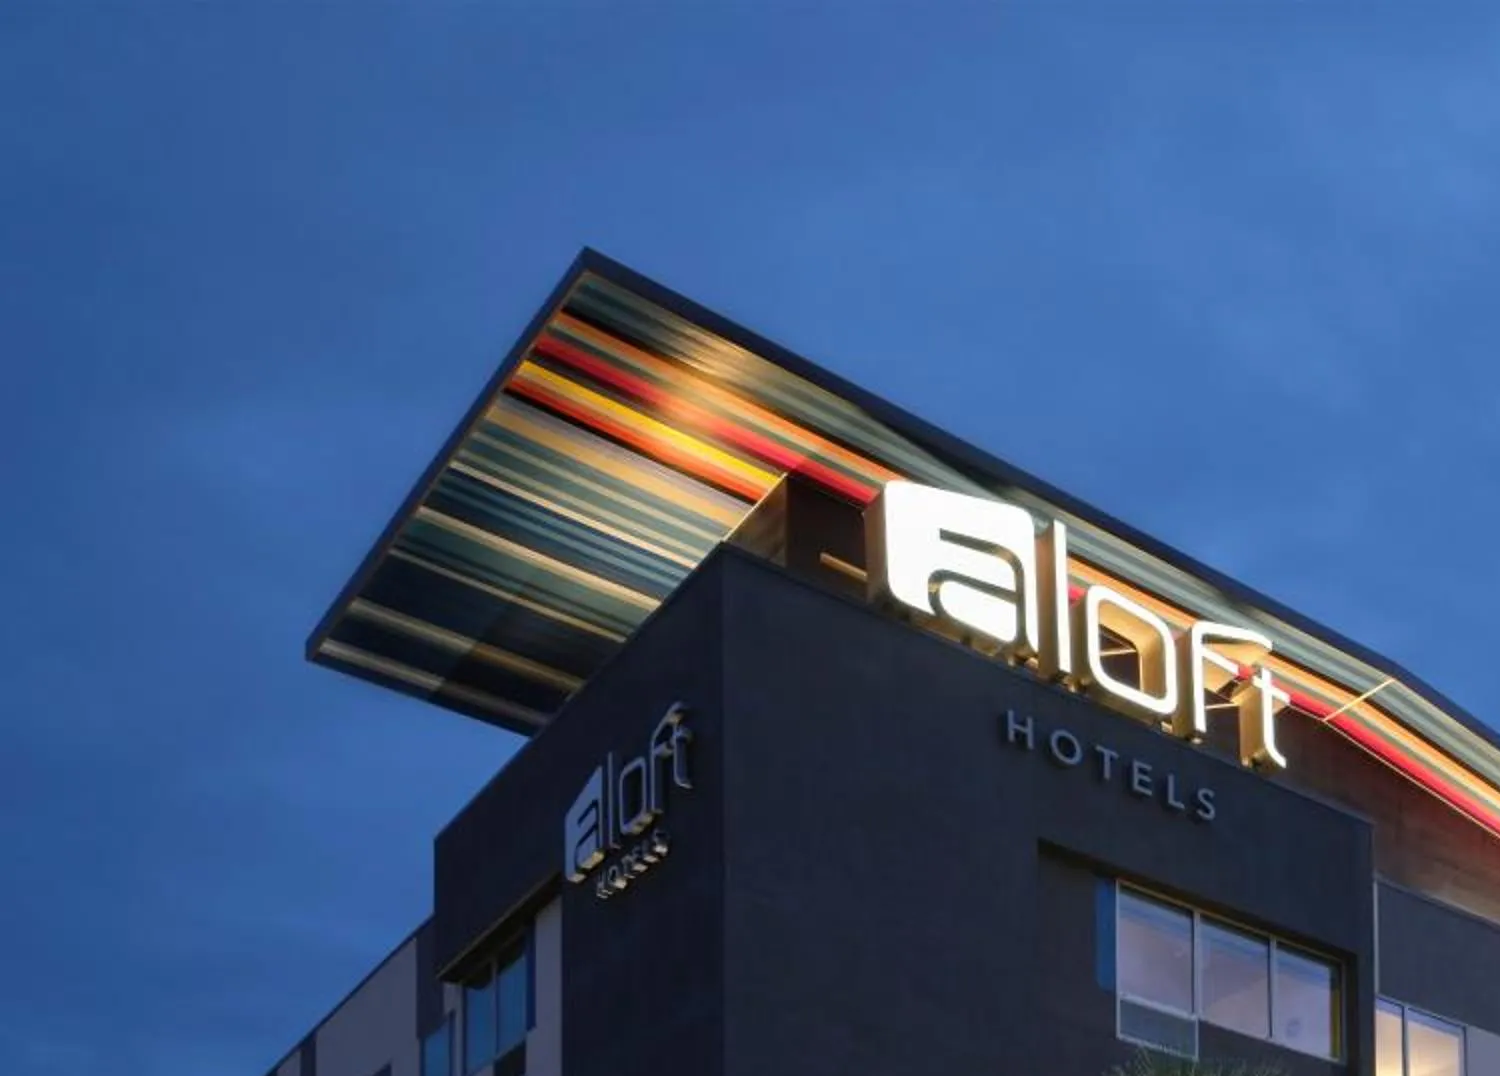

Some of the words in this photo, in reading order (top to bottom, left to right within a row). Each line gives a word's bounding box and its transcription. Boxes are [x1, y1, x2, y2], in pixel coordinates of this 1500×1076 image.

[883, 479, 1291, 770] aloft
[564, 701, 693, 884] aloft
[1005, 709, 1217, 822] HOTELS
